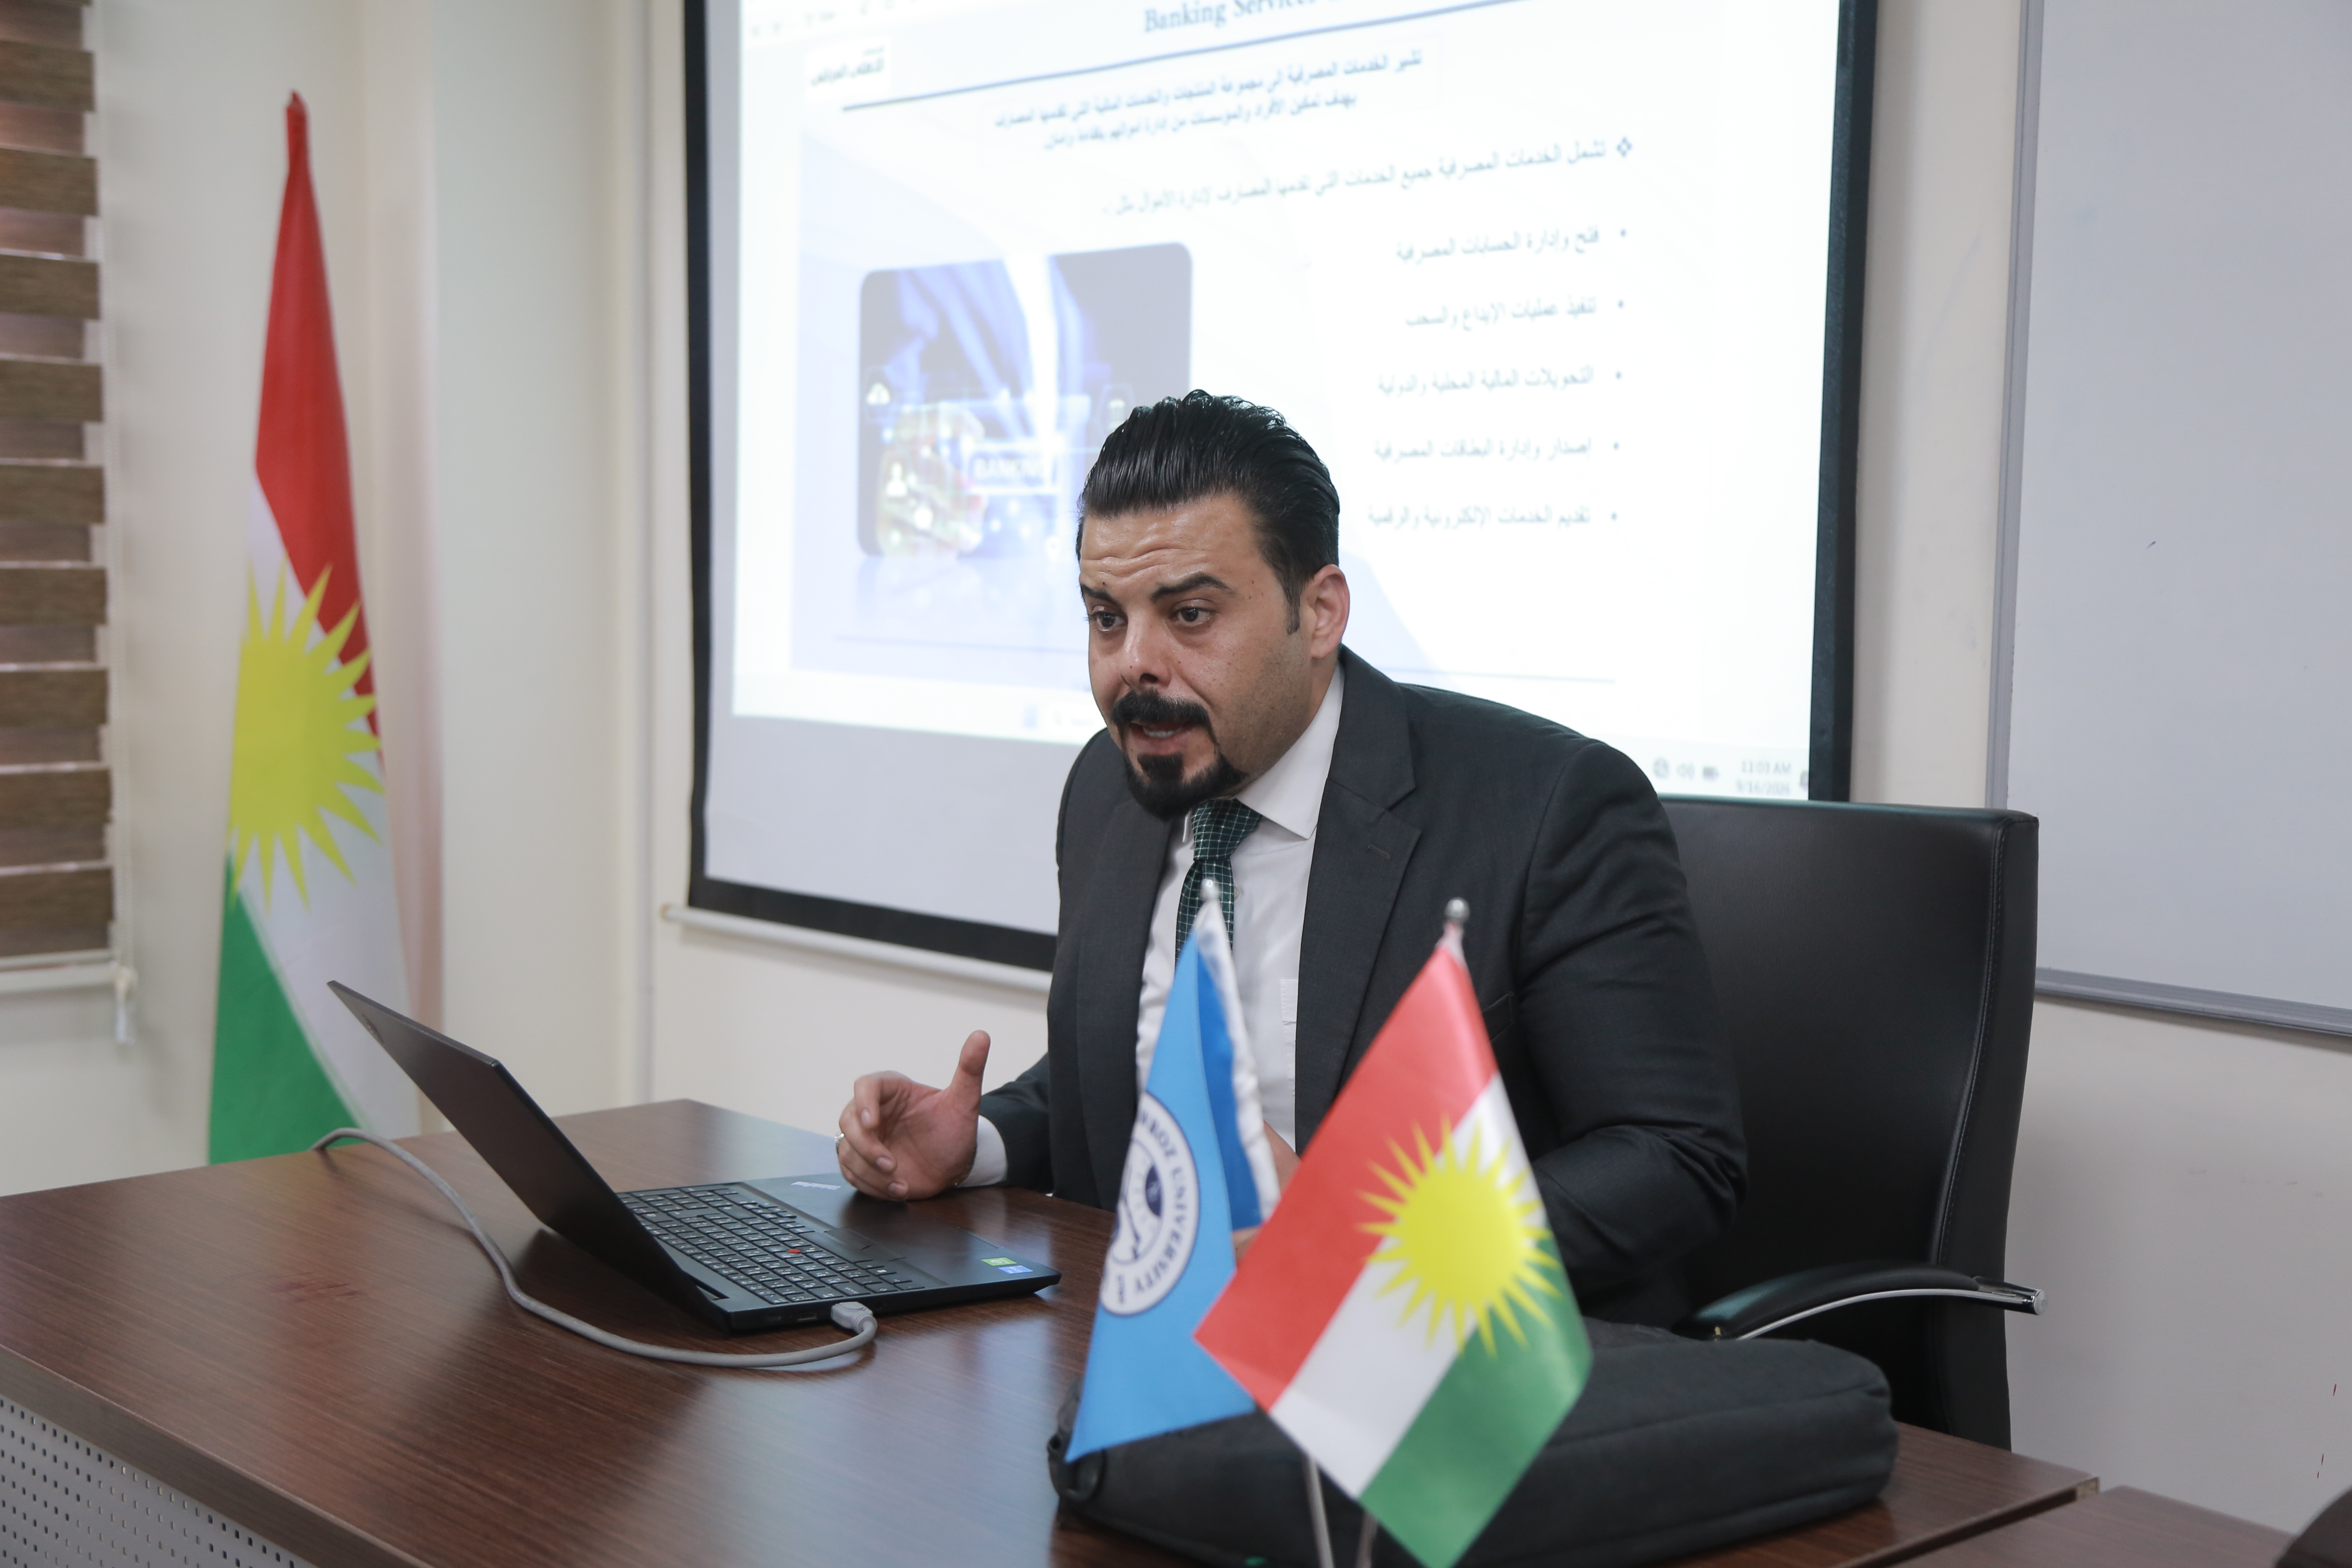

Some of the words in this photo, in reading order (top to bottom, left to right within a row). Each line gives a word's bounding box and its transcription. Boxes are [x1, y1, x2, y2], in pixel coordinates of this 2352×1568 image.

[1144, 0, 1227, 32] Banking
[1439, 151, 1500, 181] المصرفية
[1506, 143, 1561, 168] الخدمات
[1396, 236, 1456, 265] المصرفية
[1461, 230, 1521, 257] الحسابات
[1575, 224, 1599, 254] فتح
[1374, 439, 1434, 464] المصرفية
[1498, 503, 1552, 524] الخدمات
[1135, 1167, 1187, 1294] UNIVERSITY
